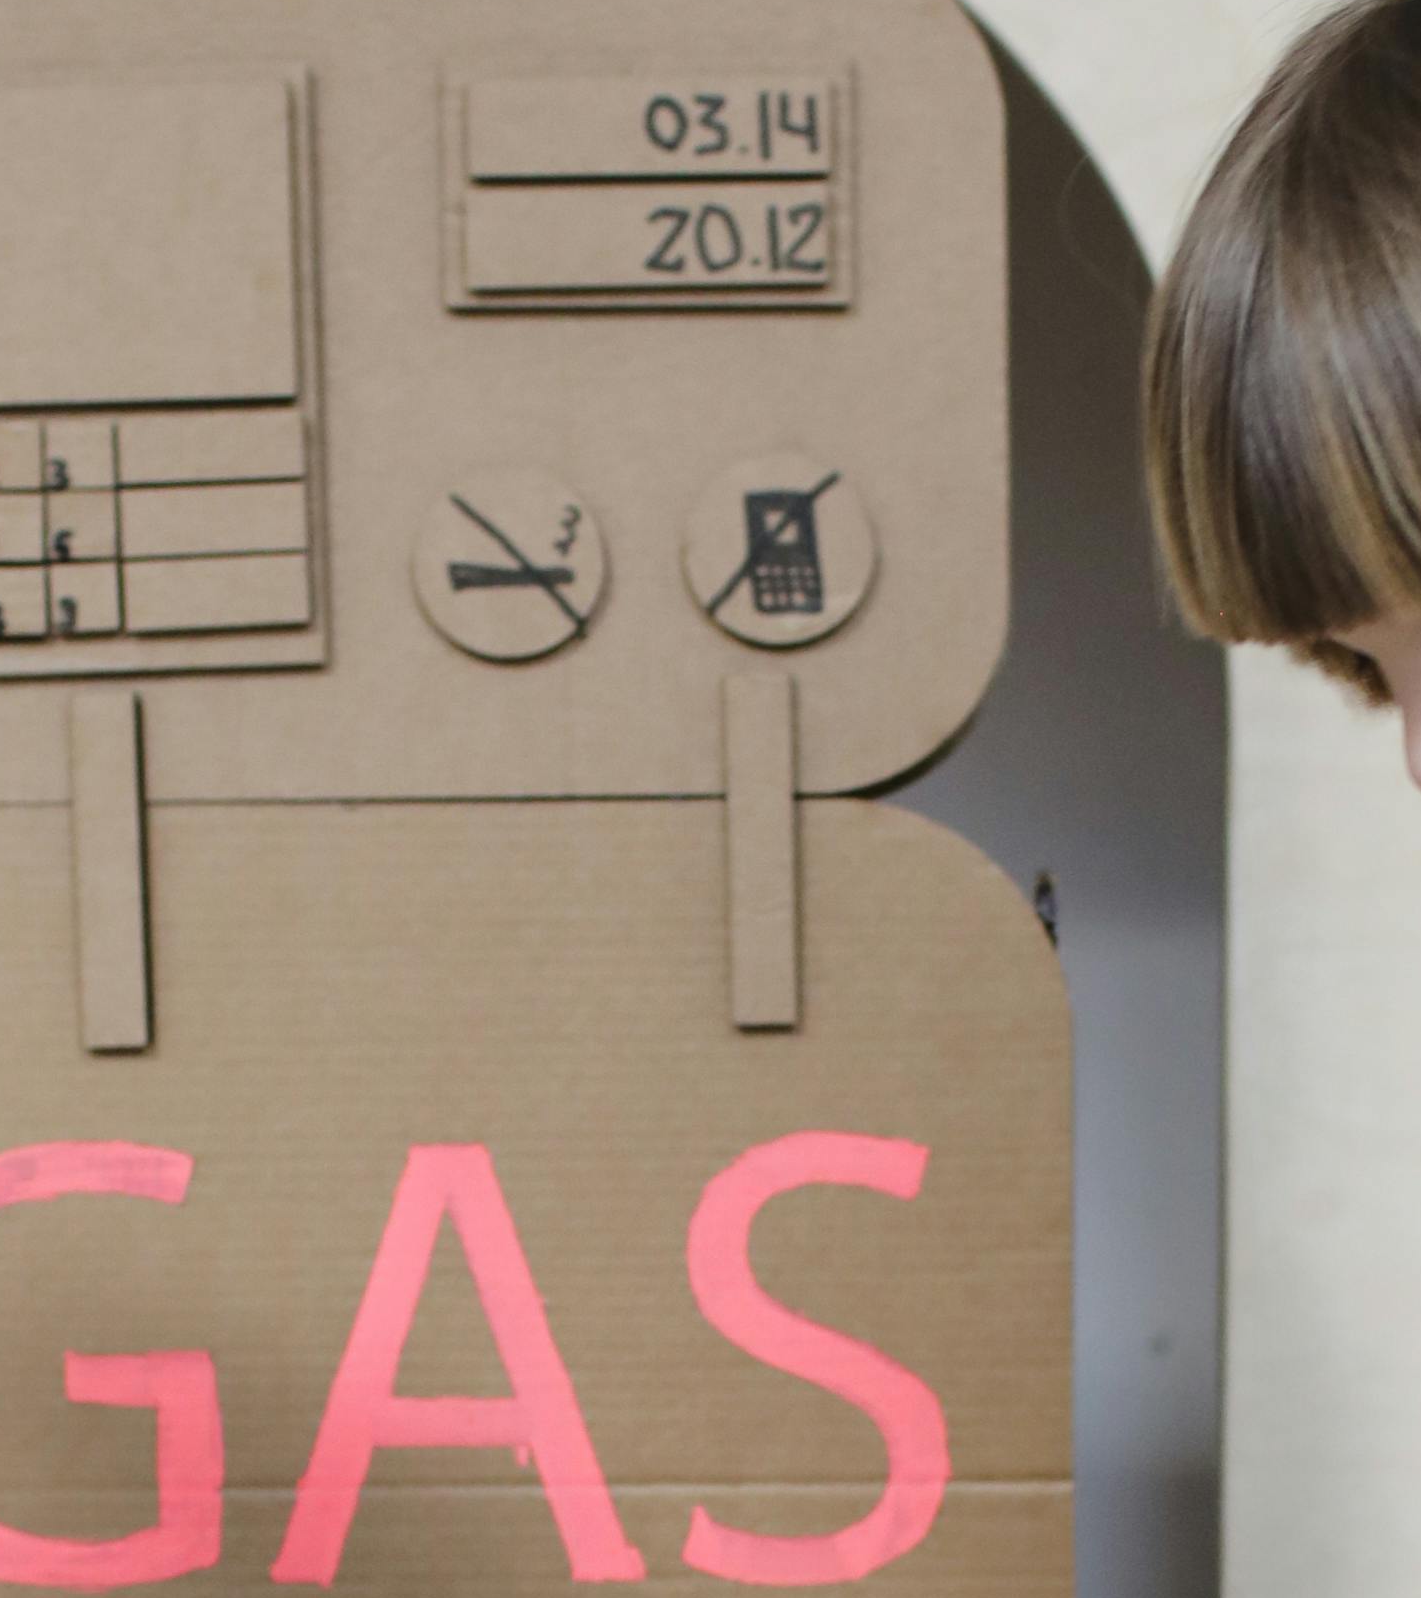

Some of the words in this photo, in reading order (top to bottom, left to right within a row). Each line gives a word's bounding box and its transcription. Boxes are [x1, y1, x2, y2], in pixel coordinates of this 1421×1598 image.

[645, 90, 819, 160] 03.14
[643, 203, 826, 273] 20.12
[52, 457, 70, 490] 3
